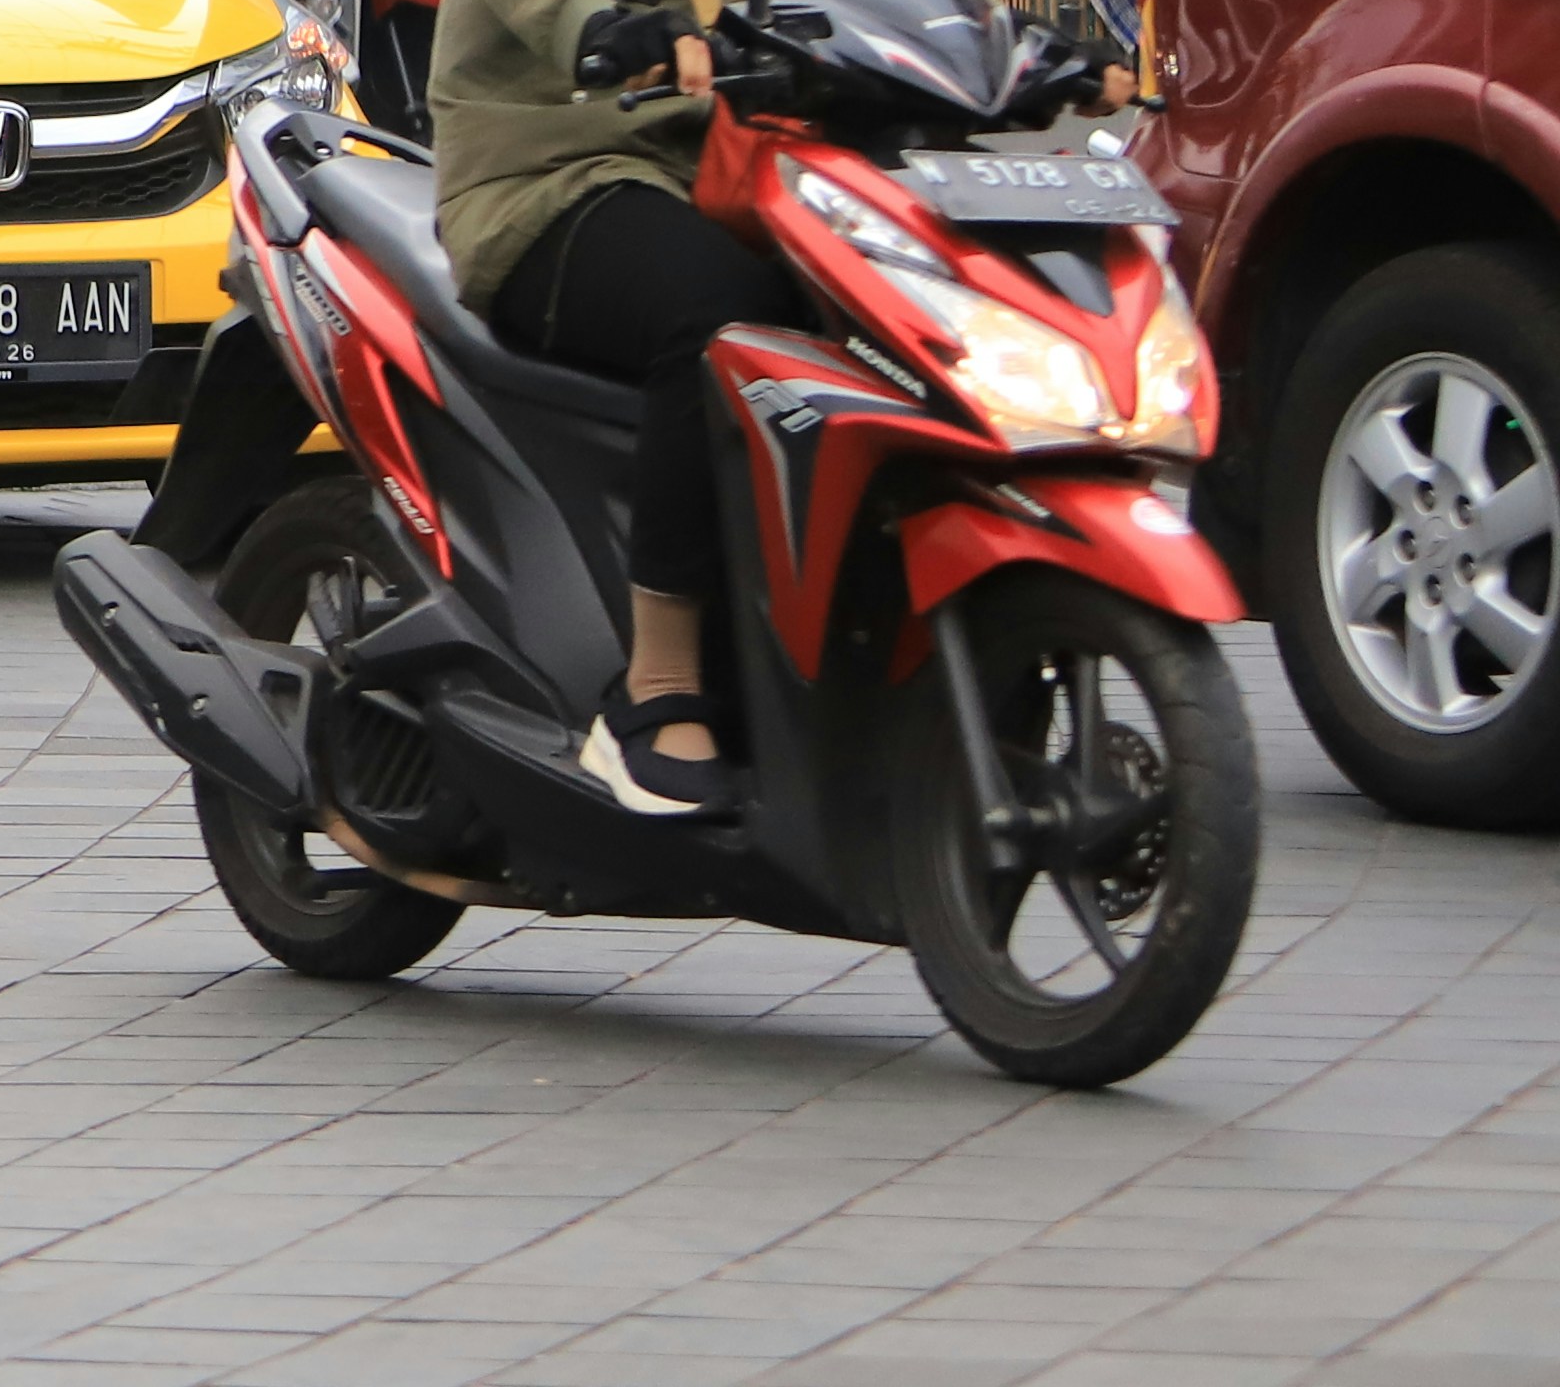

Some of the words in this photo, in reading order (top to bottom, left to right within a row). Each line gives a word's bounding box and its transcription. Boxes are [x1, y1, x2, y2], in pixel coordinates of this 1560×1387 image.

[966, 159, 1069, 188] 5128
[57, 281, 130, 334] AAN
[846, 336, 927, 399] HONDA
